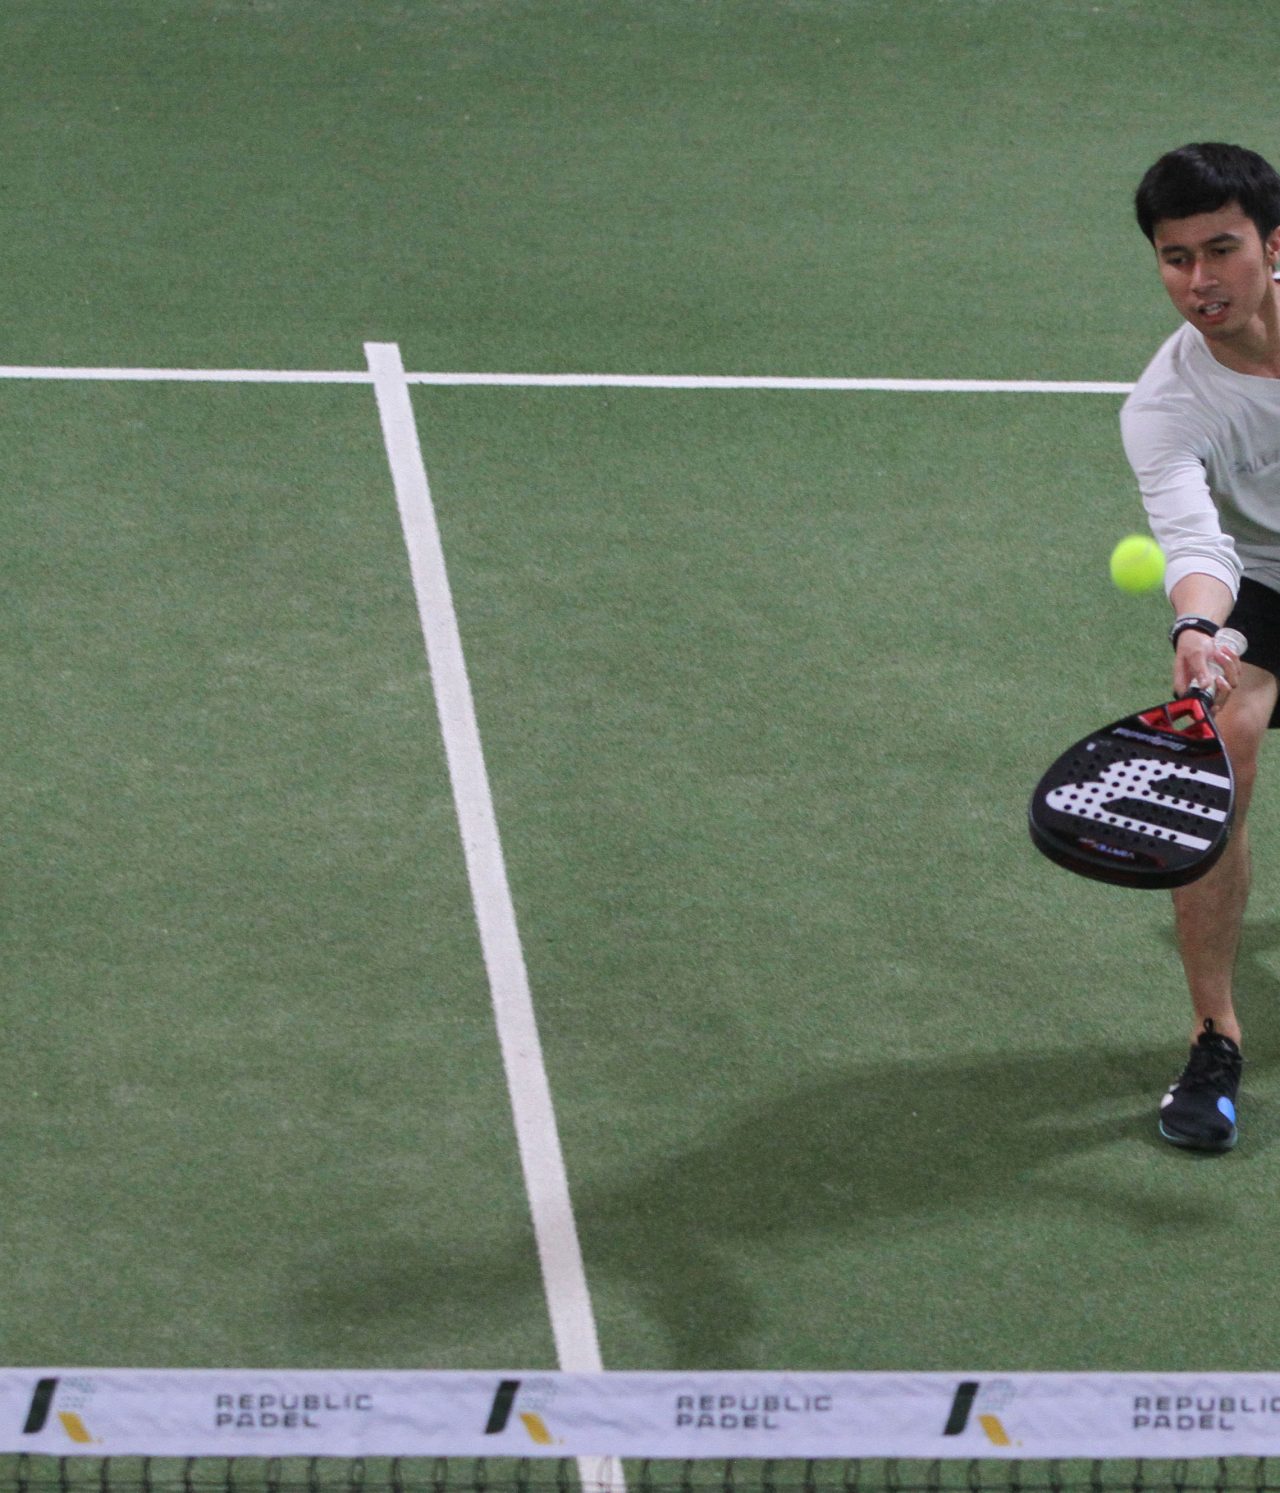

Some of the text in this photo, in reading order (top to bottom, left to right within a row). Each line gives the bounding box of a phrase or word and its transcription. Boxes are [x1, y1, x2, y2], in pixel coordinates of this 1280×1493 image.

[216, 1395, 372, 1411] REPUBLIC
[676, 1396, 831, 1412] REPUBLIC
[215, 1413, 319, 1429] PADEL
[676, 1414, 780, 1430] PADEL
[1133, 1414, 1236, 1431] PADEL
